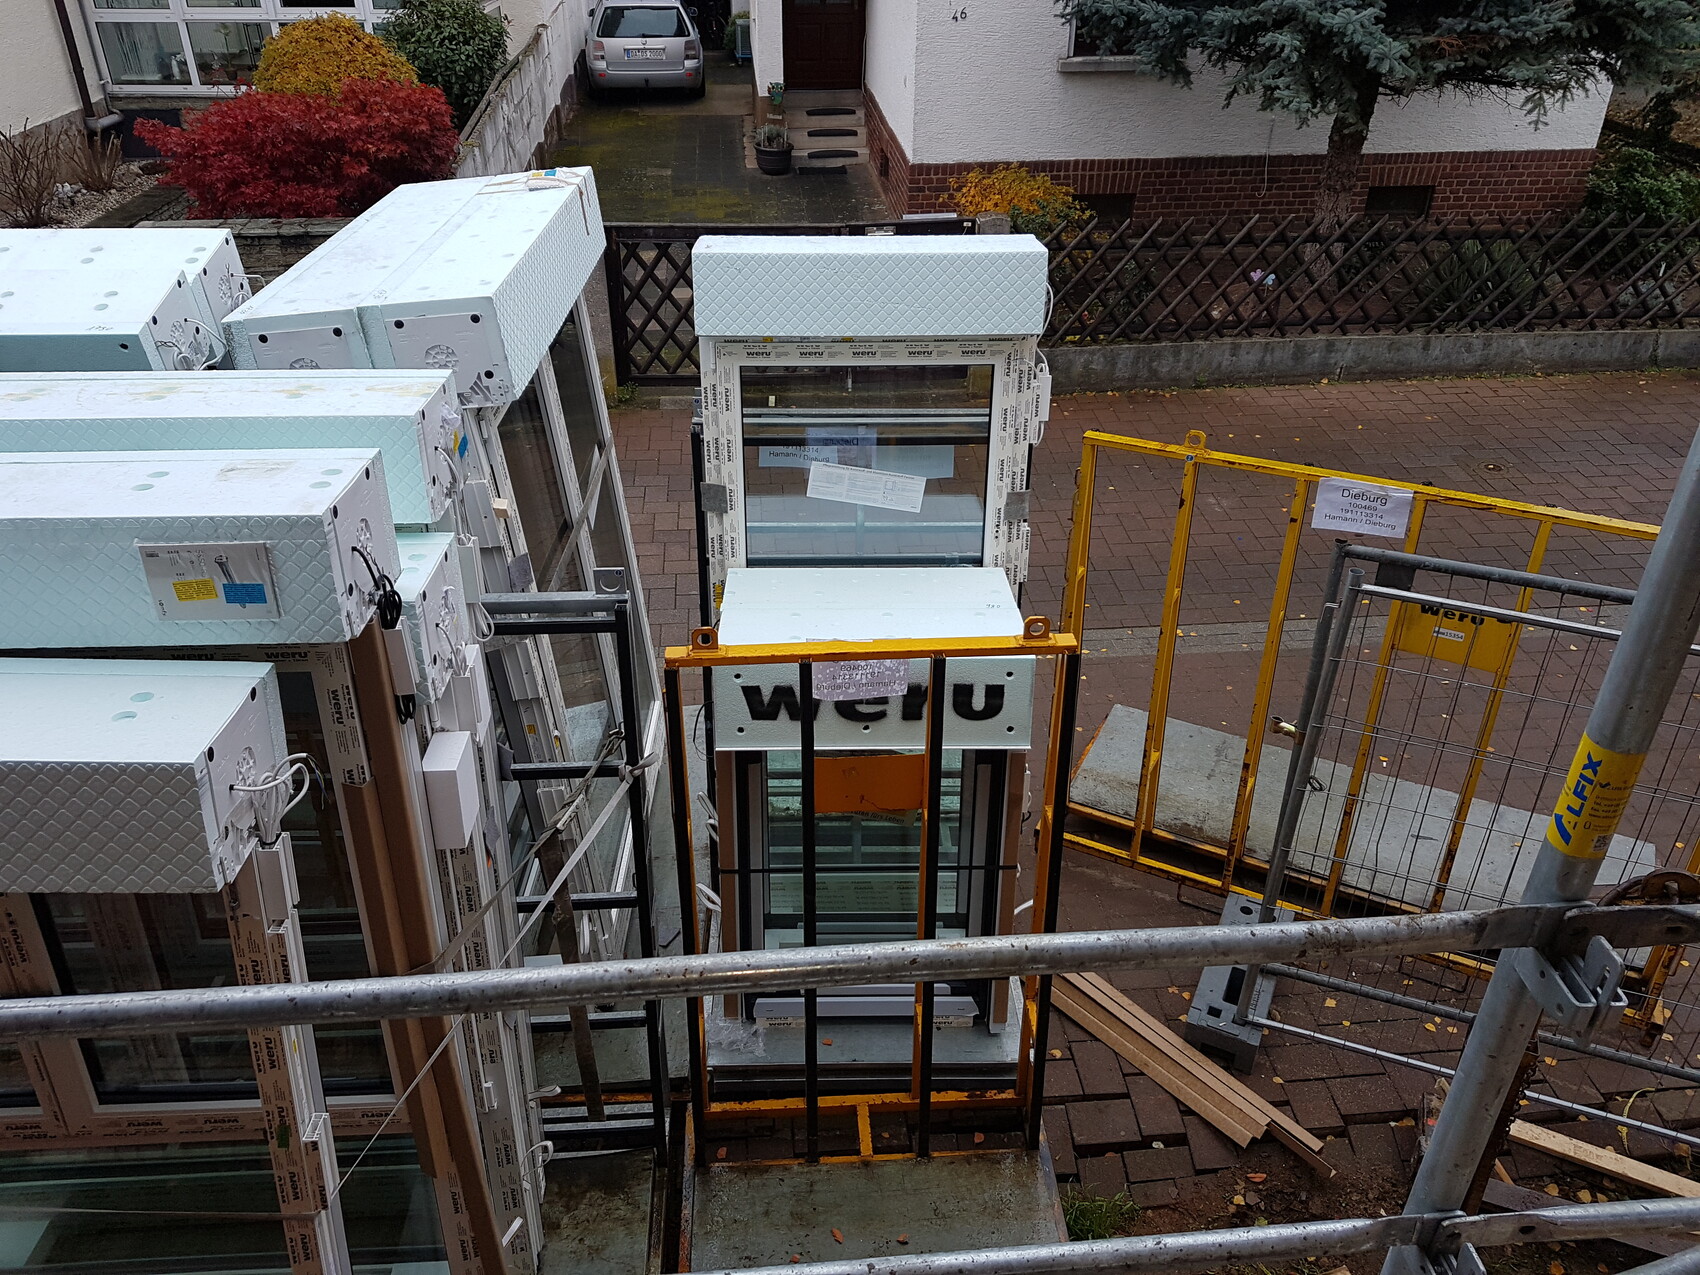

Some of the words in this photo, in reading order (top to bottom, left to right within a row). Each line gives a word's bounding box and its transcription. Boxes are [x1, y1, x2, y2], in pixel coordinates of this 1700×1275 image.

[951, 6, 967, 23] 46
[769, 450, 798, 458] Hamann
[1341, 488, 1388, 507] Dieburg
[1348, 502, 1378, 512] 100469
[1324, 513, 1358, 523] Hamann
[1364, 520, 1397, 531] Dieburg
[1340, 508, 1384, 520] 191113314
[1421, 604, 1485, 626] weru
[264, 651, 309, 659] weru
[330, 689, 344, 725] weru
[741, 684, 1005, 722] weru
[465, 886, 474, 912] weru
[473, 941, 481, 967] weru
[265, 1037, 277, 1070] weru
[289, 1171, 300, 1201] weru
[300, 1233, 311, 1261] weru
